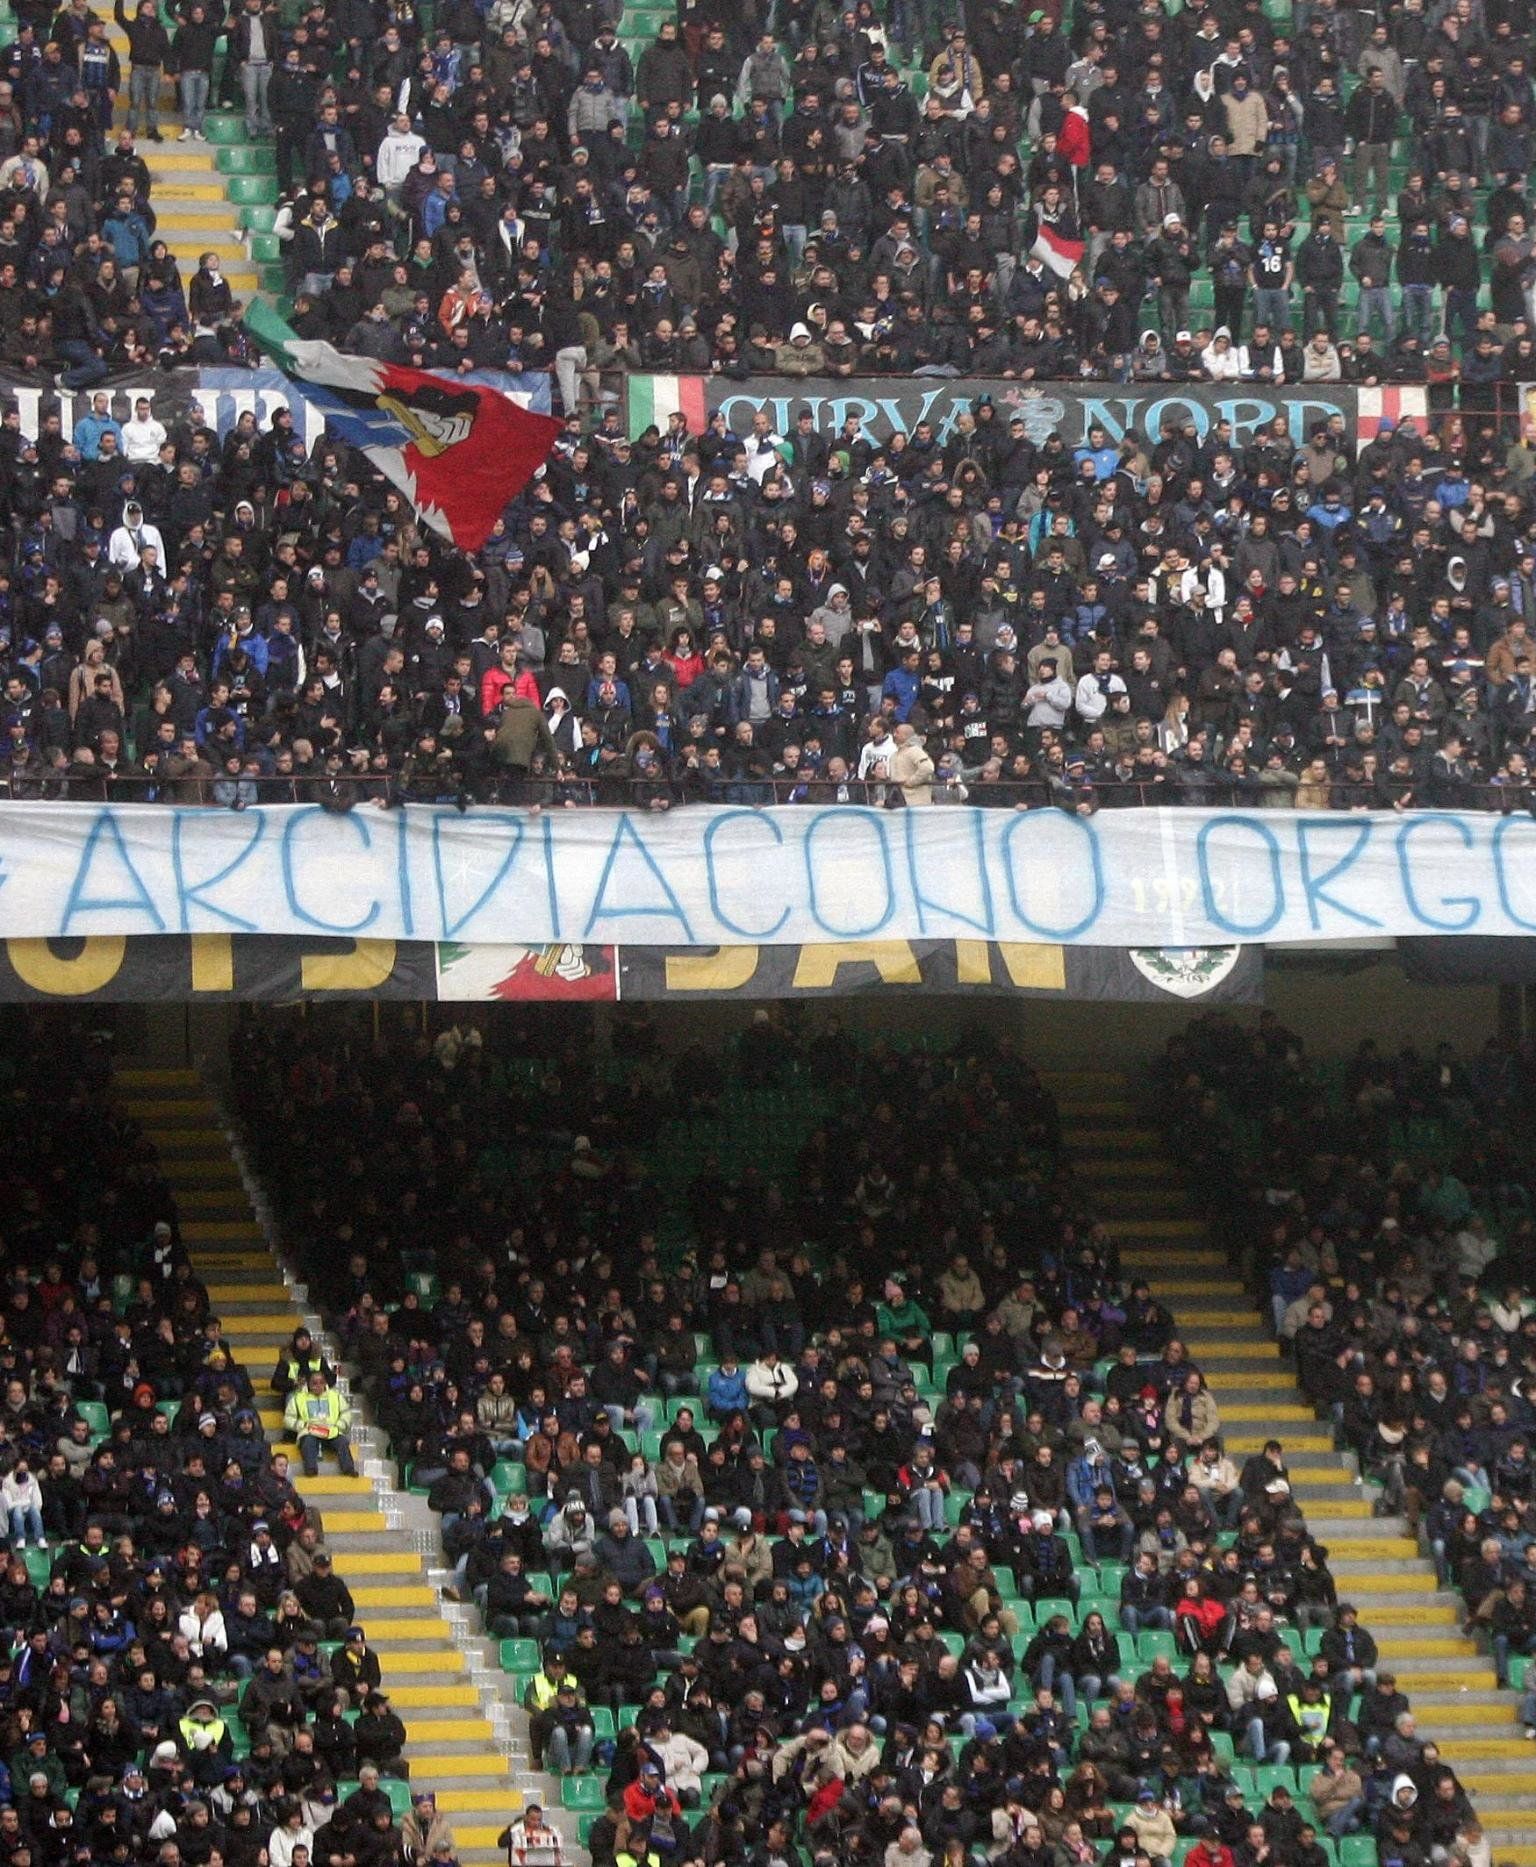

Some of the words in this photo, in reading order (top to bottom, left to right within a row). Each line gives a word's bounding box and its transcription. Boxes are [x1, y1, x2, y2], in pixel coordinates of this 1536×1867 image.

[1262, 254, 1282, 273] 16
[718, 386, 974, 449] CURVA
[1071, 397, 1346, 449] NORD
[60, 804, 1104, 942] ARCIDIACONO
